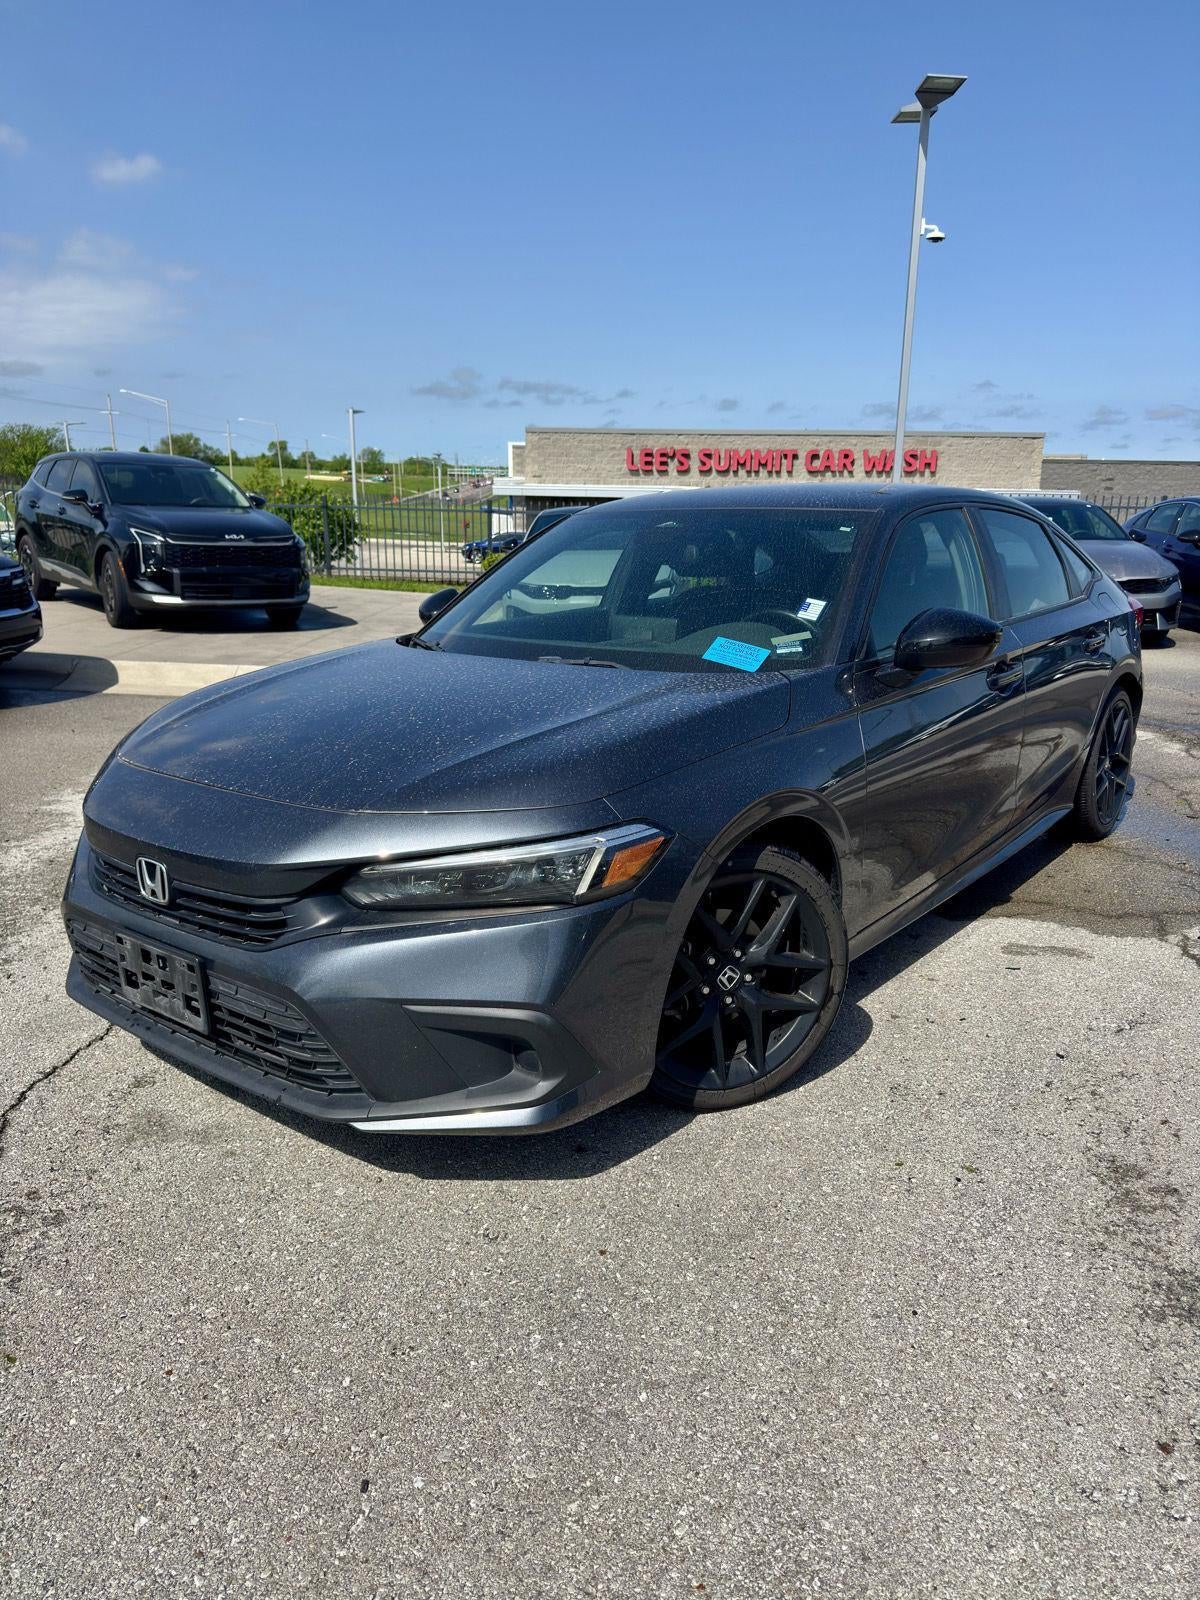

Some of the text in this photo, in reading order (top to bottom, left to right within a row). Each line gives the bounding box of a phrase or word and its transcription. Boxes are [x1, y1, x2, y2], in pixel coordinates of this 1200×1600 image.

[626, 447, 690, 472] LEE'S
[698, 447, 797, 472] SUMMIT
[805, 448, 855, 473] CAR
